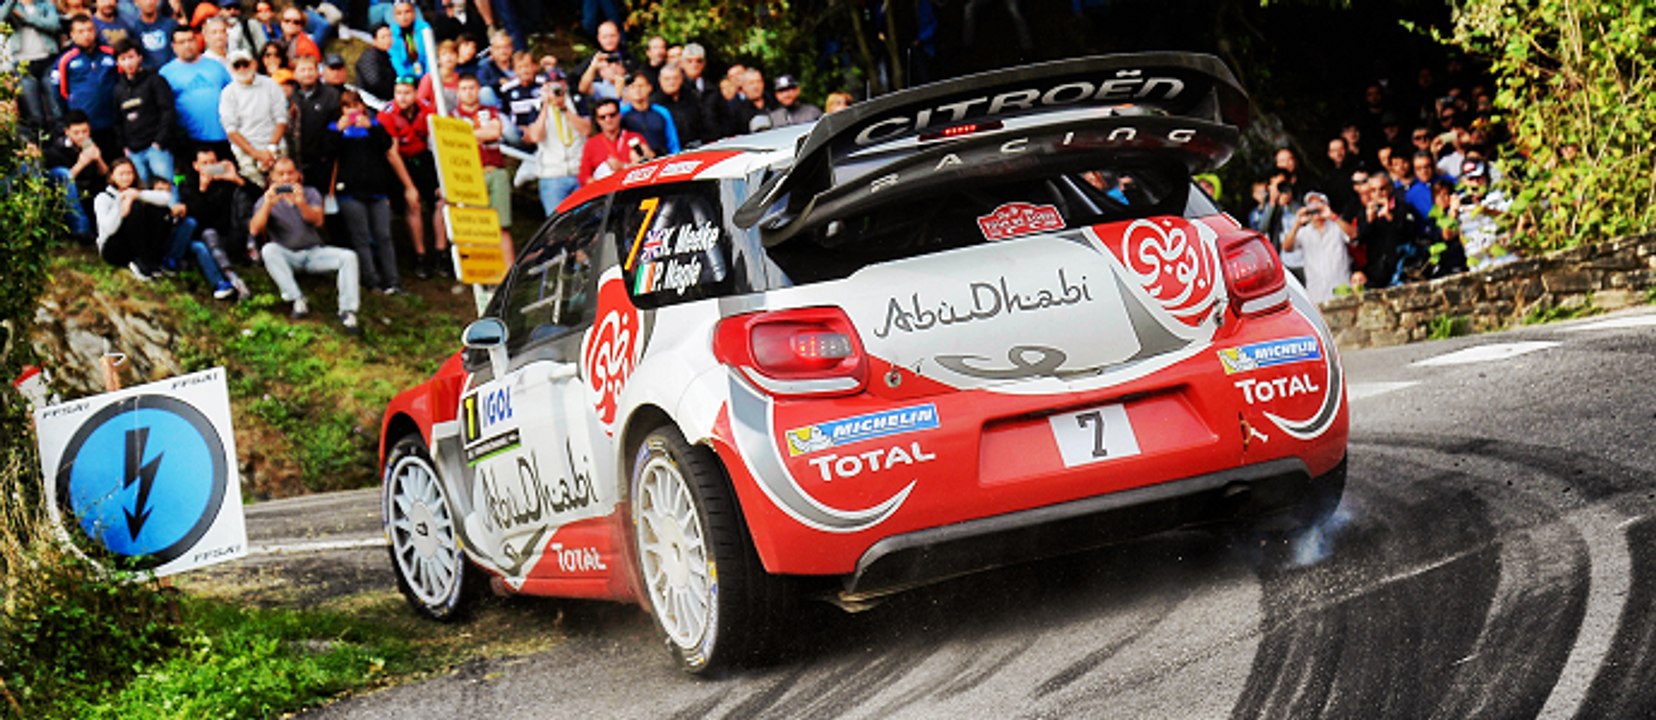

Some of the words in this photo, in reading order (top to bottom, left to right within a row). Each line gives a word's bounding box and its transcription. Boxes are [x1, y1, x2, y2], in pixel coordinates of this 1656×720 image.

[855, 69, 1185, 145] CITROËN
[623, 196, 660, 271] 7
[1254, 341, 1317, 359] MICHELIN
[482, 385, 513, 429] IGOL
[1234, 373, 1320, 405] TOTAL
[832, 408, 932, 439] MICHELIN
[1075, 409, 1108, 458] 7
[808, 441, 937, 482] TOTAL
[550, 542, 608, 573] TOTAL
